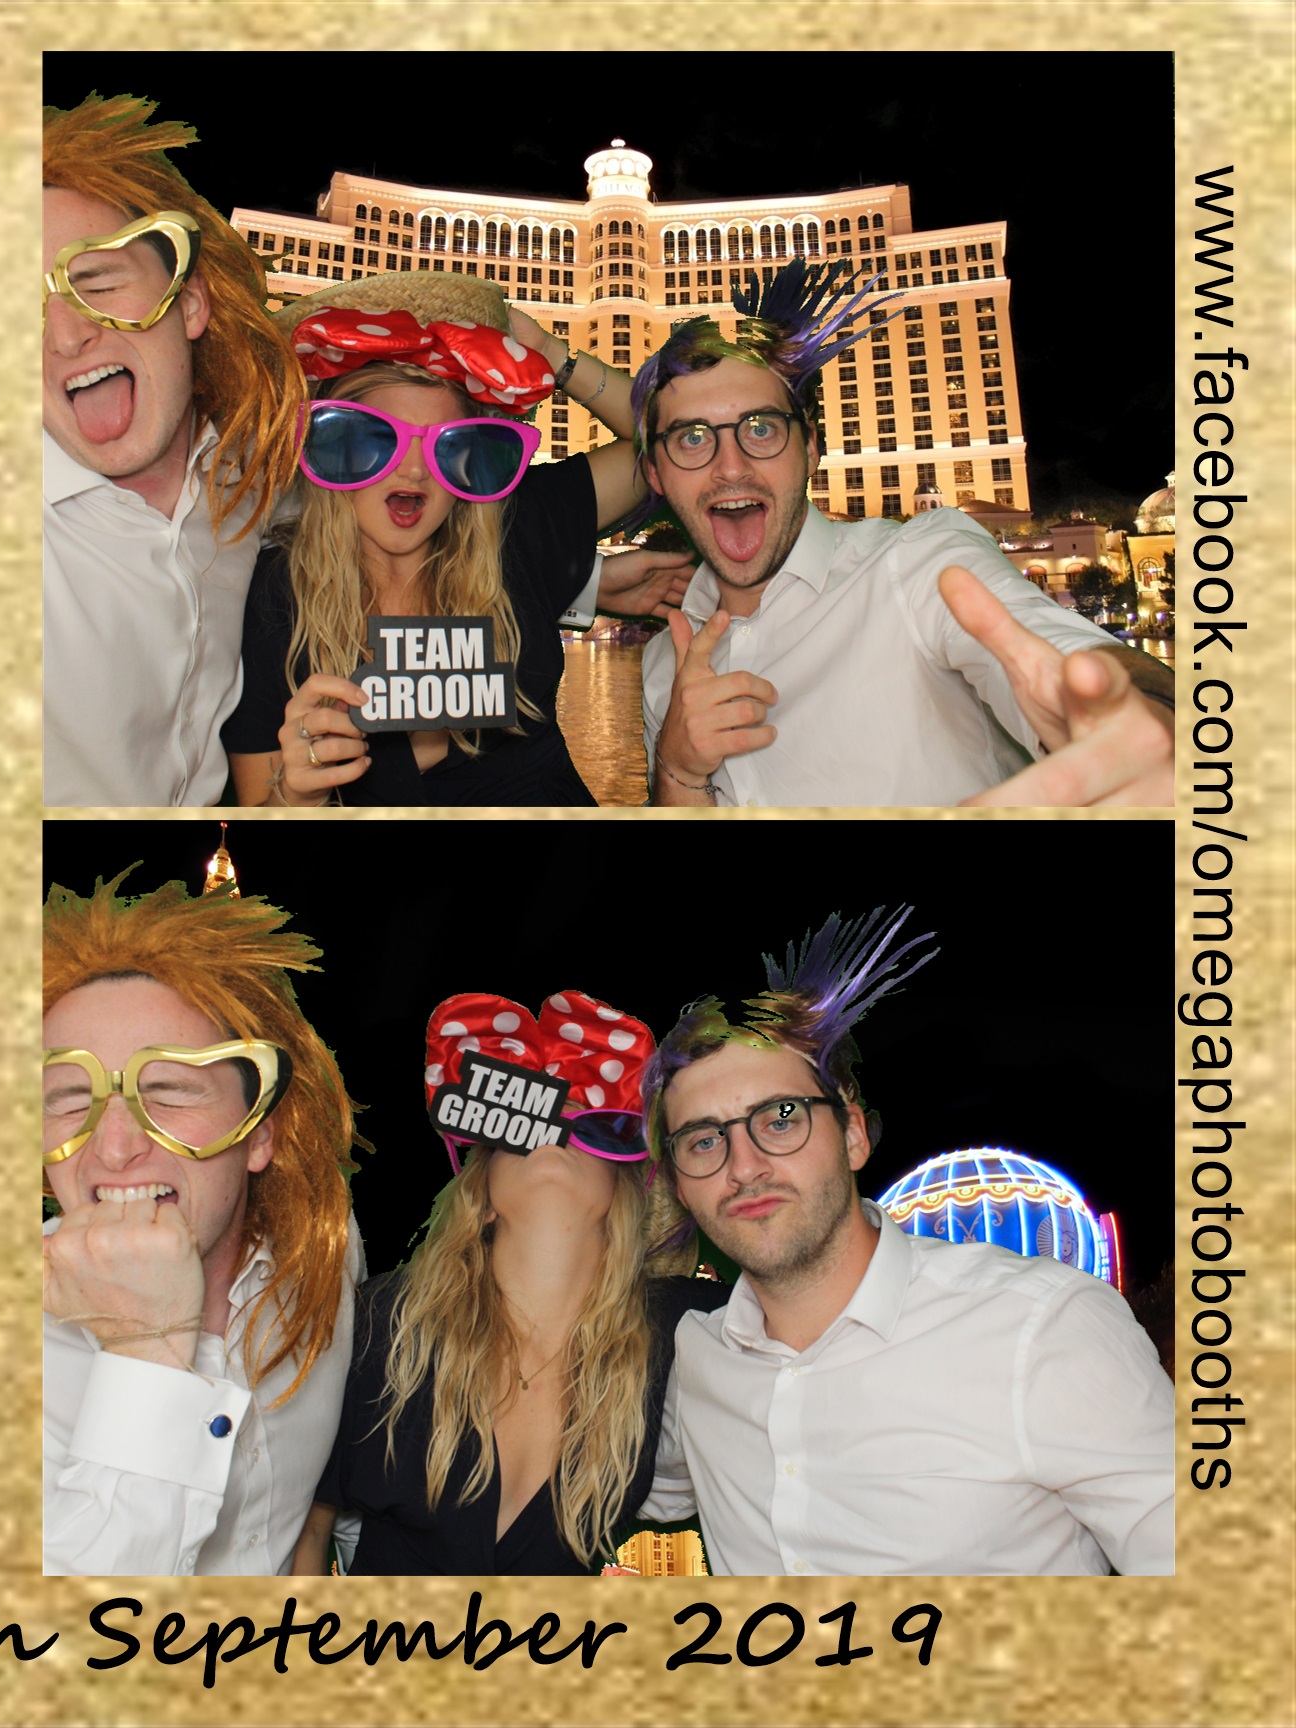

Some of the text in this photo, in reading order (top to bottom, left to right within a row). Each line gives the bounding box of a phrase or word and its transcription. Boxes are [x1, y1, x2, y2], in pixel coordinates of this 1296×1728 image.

[379, 627, 484, 671] TEAM
[360, 673, 506, 721] GROOM
[467, 1063, 559, 1119] TEAM
[437, 1093, 563, 1151] GROOM
